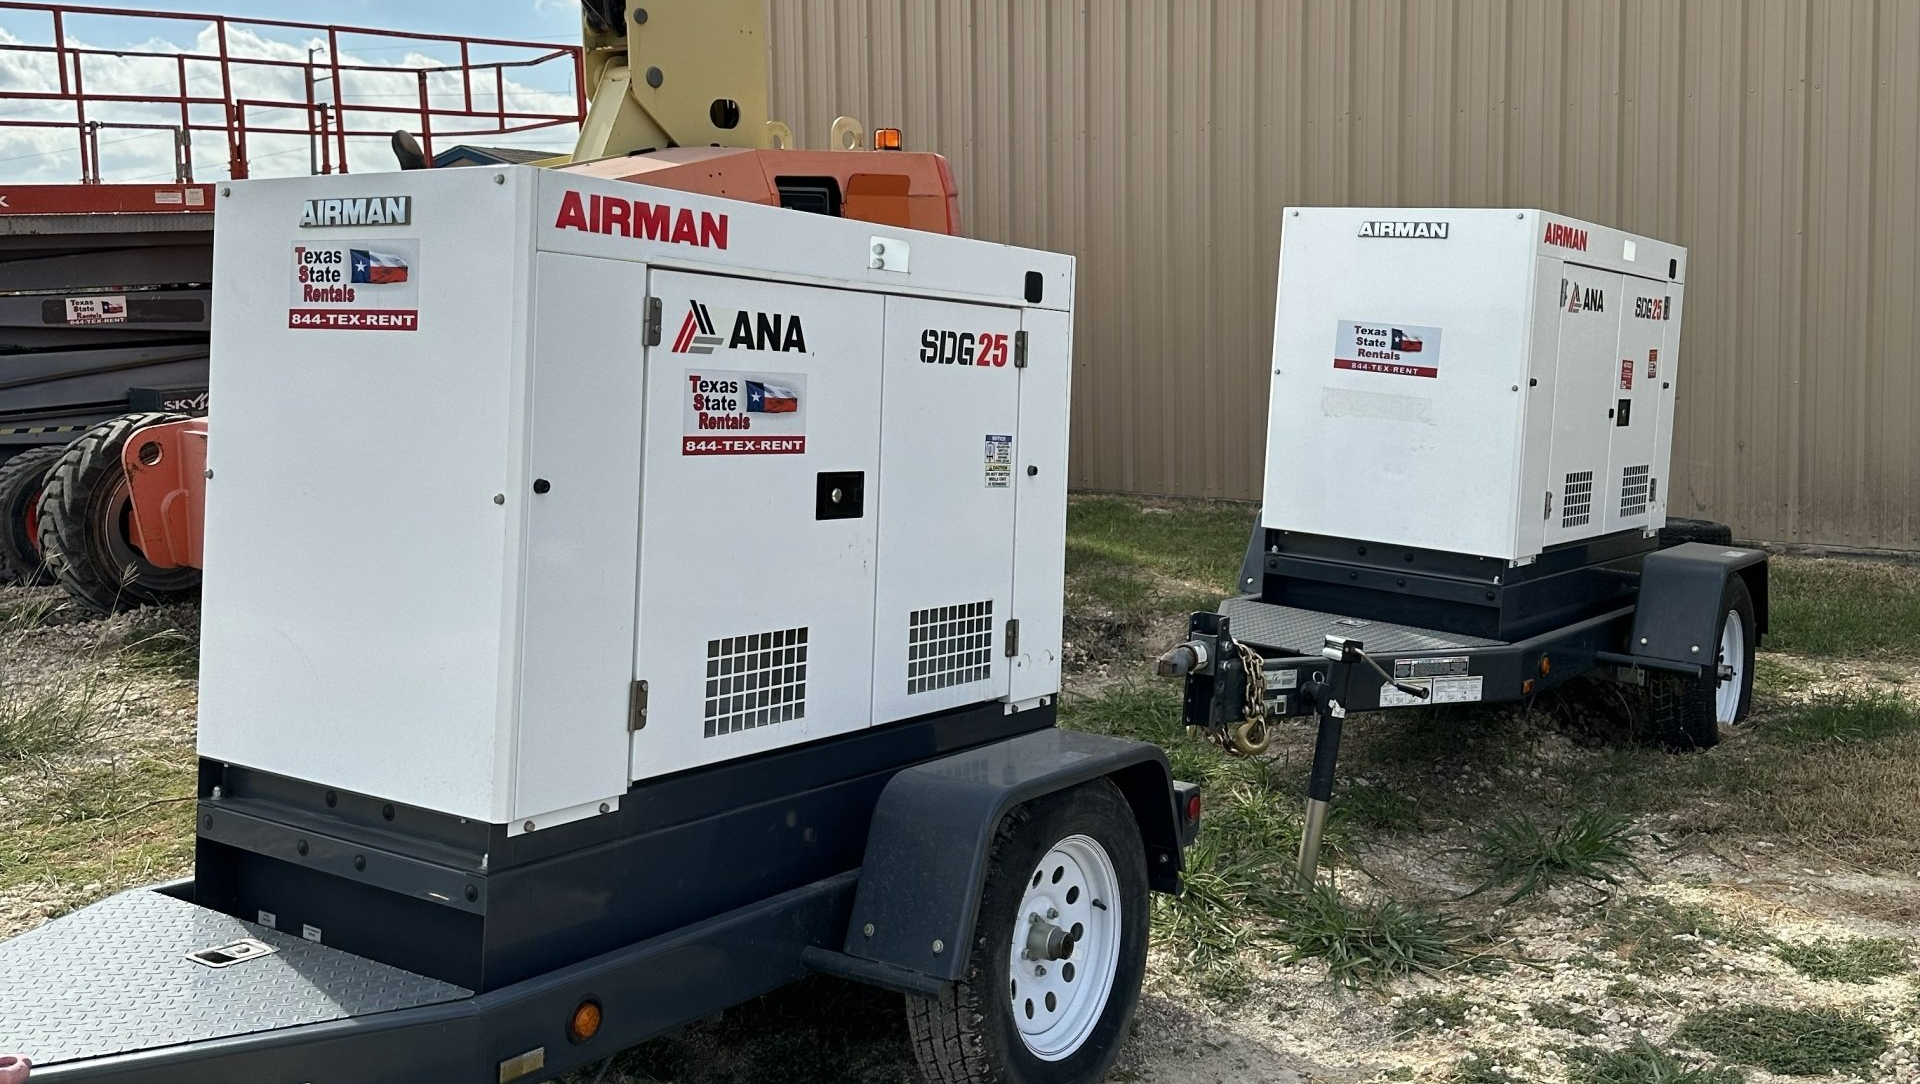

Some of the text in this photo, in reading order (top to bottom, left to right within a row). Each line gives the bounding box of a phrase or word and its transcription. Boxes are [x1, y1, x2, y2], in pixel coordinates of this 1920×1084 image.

[300, 196, 408, 227] AIRMAN
[555, 190, 728, 250] AIRMAN
[1358, 222, 1448, 238] AIRMAN
[1544, 222, 1588, 252] AIRMAN
[295, 247, 342, 265] Texas
[298, 265, 341, 283] State
[303, 284, 355, 302] Rentals
[1583, 287, 1604, 313] ANA
[1635, 296, 1663, 321] SDG25
[291, 313, 415, 326] 844-TEX-RENT
[728, 310, 807, 354] ANA
[1354, 325, 1387, 337] Texas
[920, 329, 1008, 367] SDG25
[1356, 337, 1386, 348] State
[1357, 348, 1400, 361] Rentals
[1351, 362, 1418, 376] 844-TEX-RENT
[689, 375, 738, 394] Texas
[693, 394, 737, 411] State
[699, 412, 750, 430] Rentals
[685, 440, 803, 452] 844-TEX-RENT
